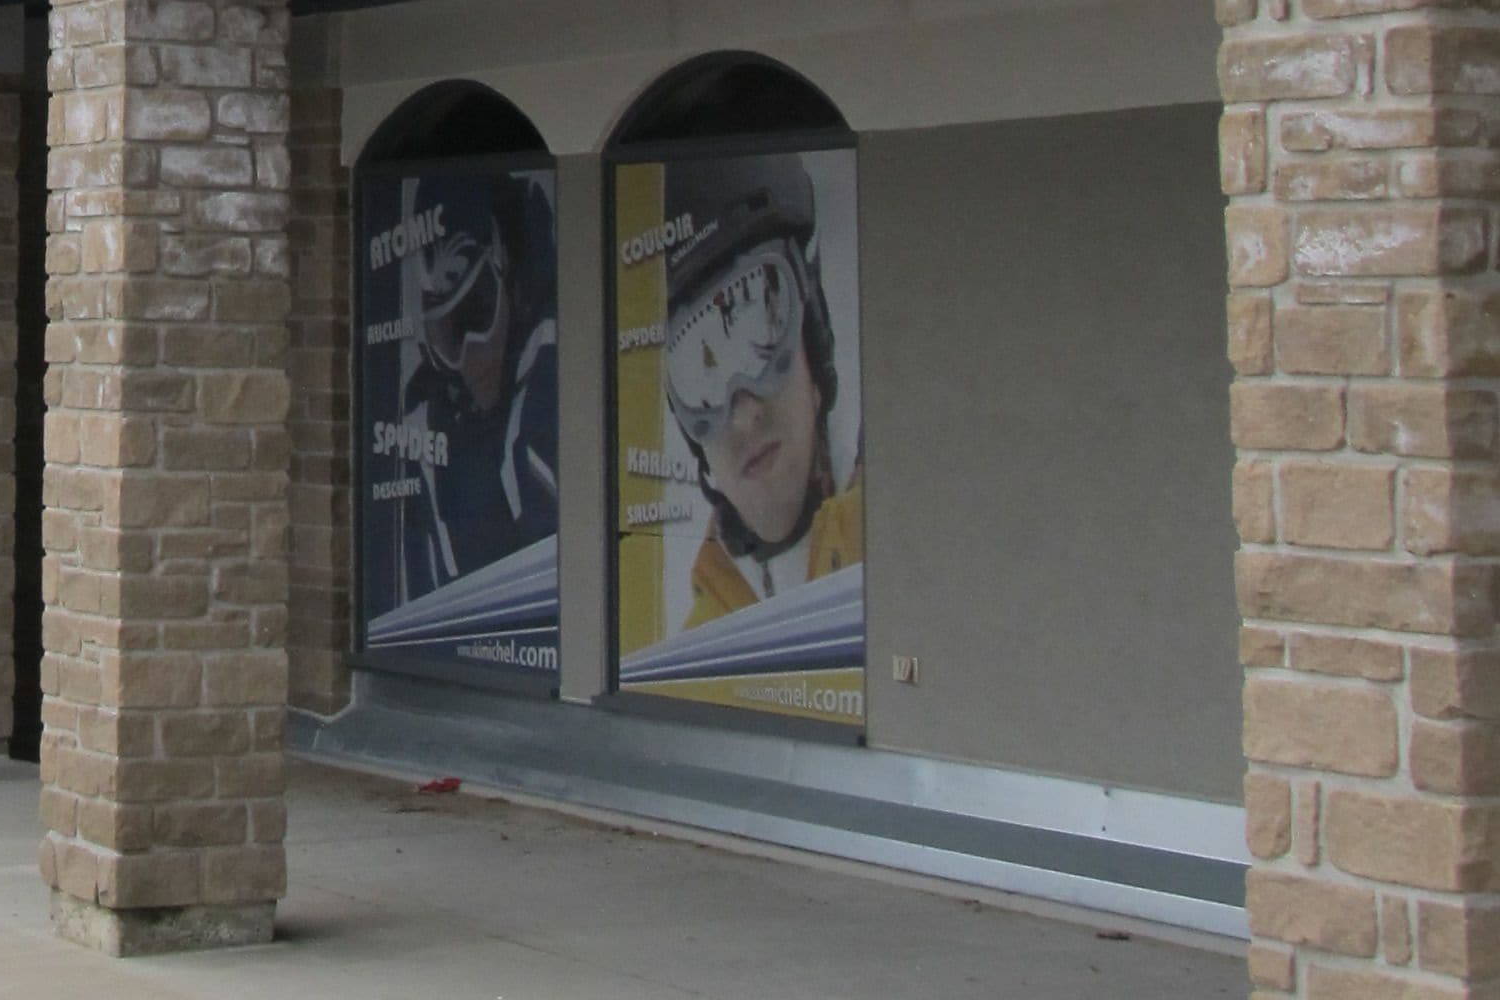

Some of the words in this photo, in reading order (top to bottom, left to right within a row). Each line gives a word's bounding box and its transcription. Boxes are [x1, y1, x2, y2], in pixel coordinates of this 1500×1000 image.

[370, 203, 446, 271] ATOMIC
[622, 212, 695, 266] COULOIR
[372, 421, 449, 467] SPYDER
